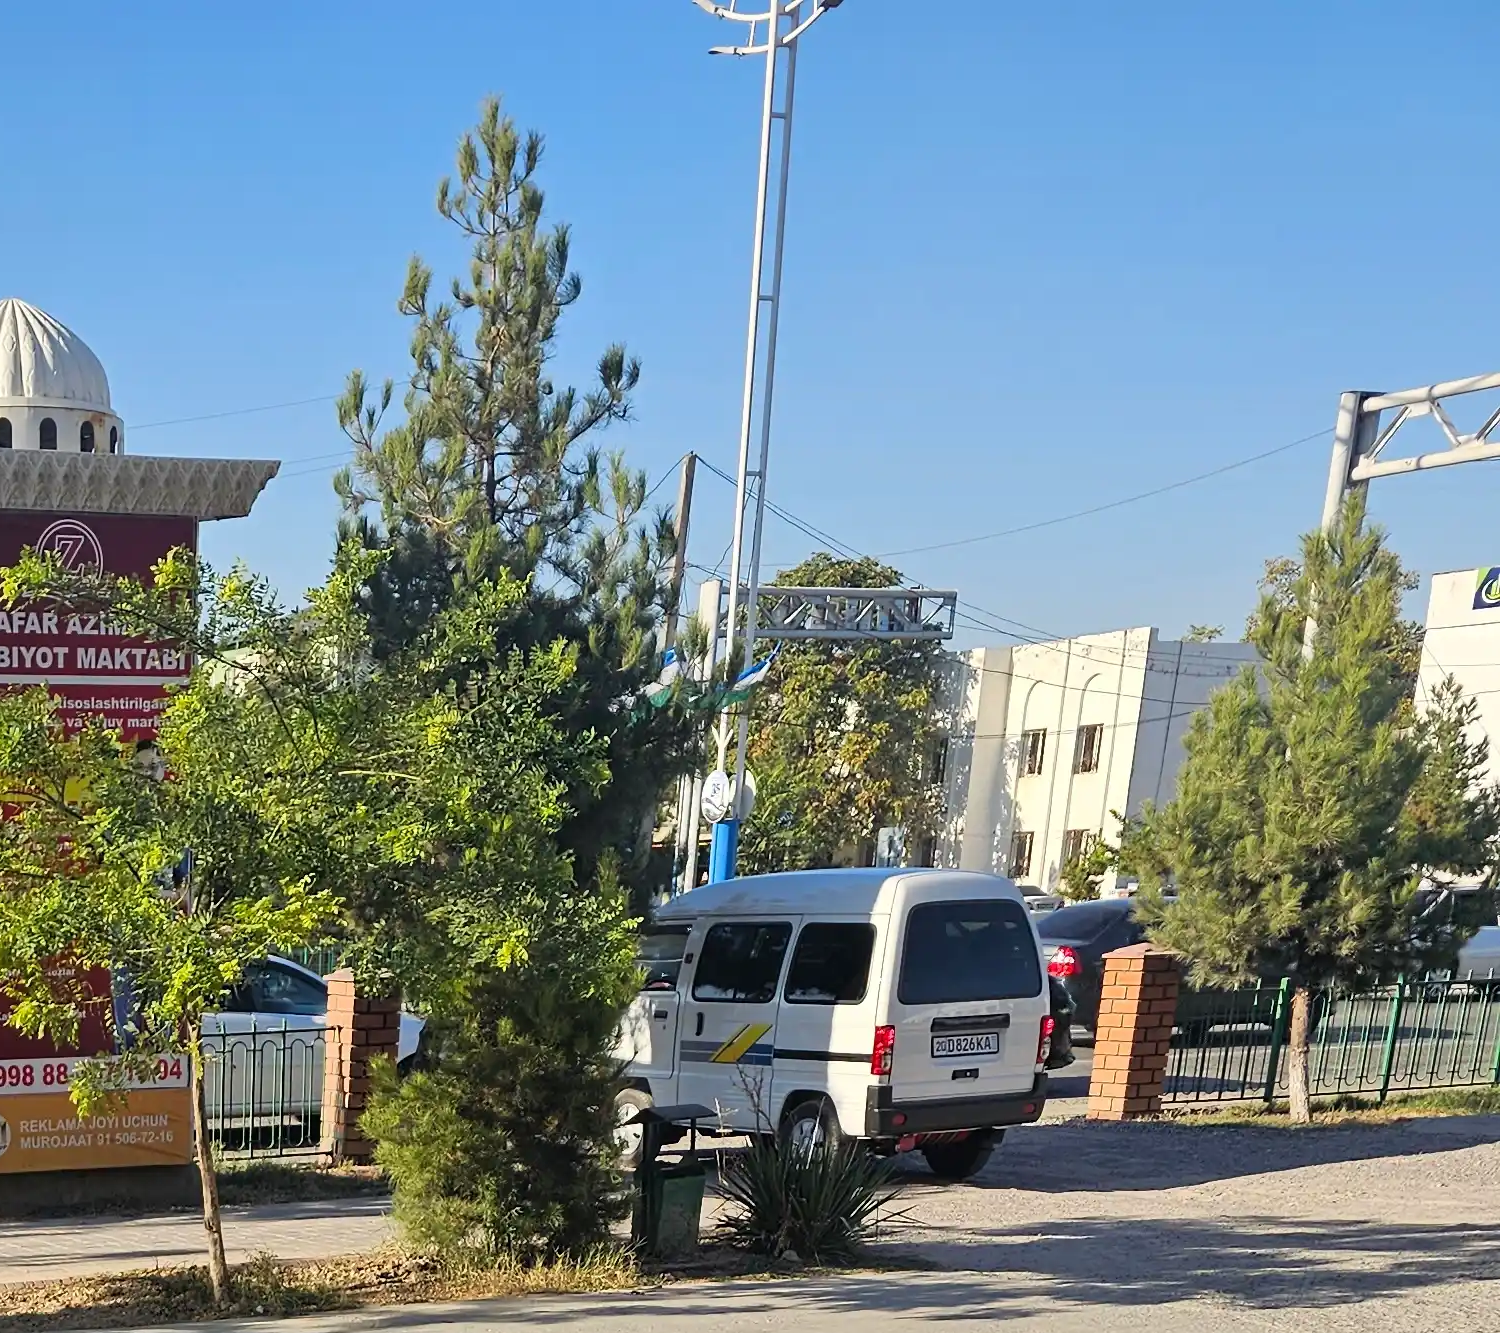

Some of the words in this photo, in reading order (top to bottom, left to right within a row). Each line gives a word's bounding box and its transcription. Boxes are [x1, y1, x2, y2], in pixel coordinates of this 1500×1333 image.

[77, 647, 186, 670] MAKTABI
[67, 718, 83, 728] va
[947, 1036, 992, 1053] D826KA
[43, 1063, 69, 1086] 88
[19, 1119, 86, 1132] REKLAMA
[89, 1116, 119, 1130] JOYI
[122, 1114, 168, 1129] UCHUN
[20, 1133, 93, 1149] MUROJAAT
[97, 1132, 110, 1145] 91
